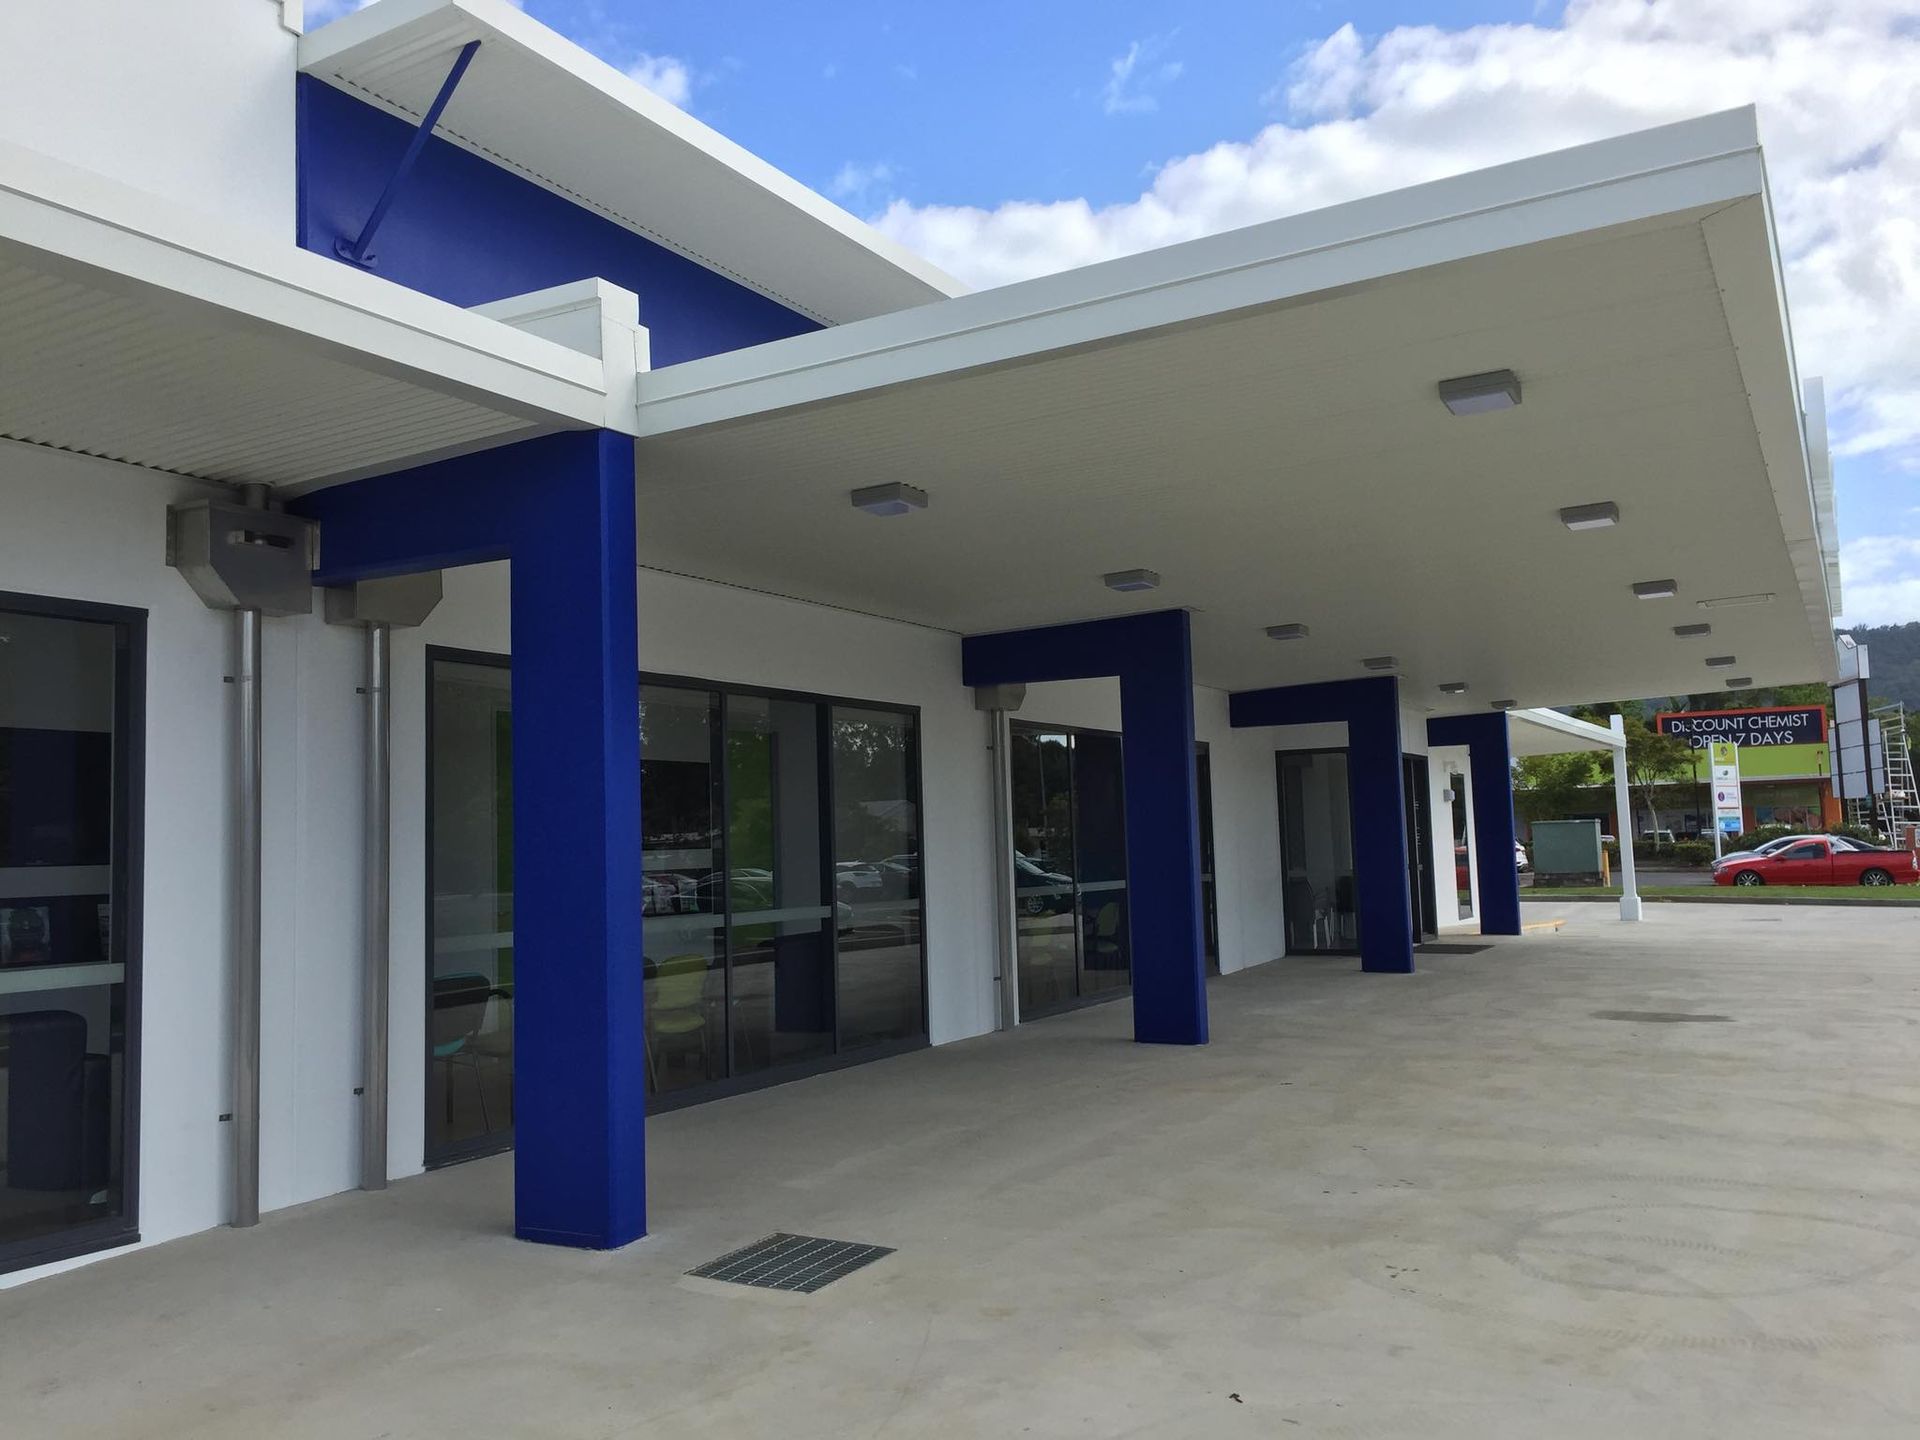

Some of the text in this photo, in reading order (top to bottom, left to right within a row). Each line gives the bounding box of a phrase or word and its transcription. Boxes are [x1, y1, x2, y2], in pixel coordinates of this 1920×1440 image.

[1748, 713, 1809, 729] CHEMIST
[1735, 732, 1746, 746] 7
[1750, 730, 1794, 746] DAYS
